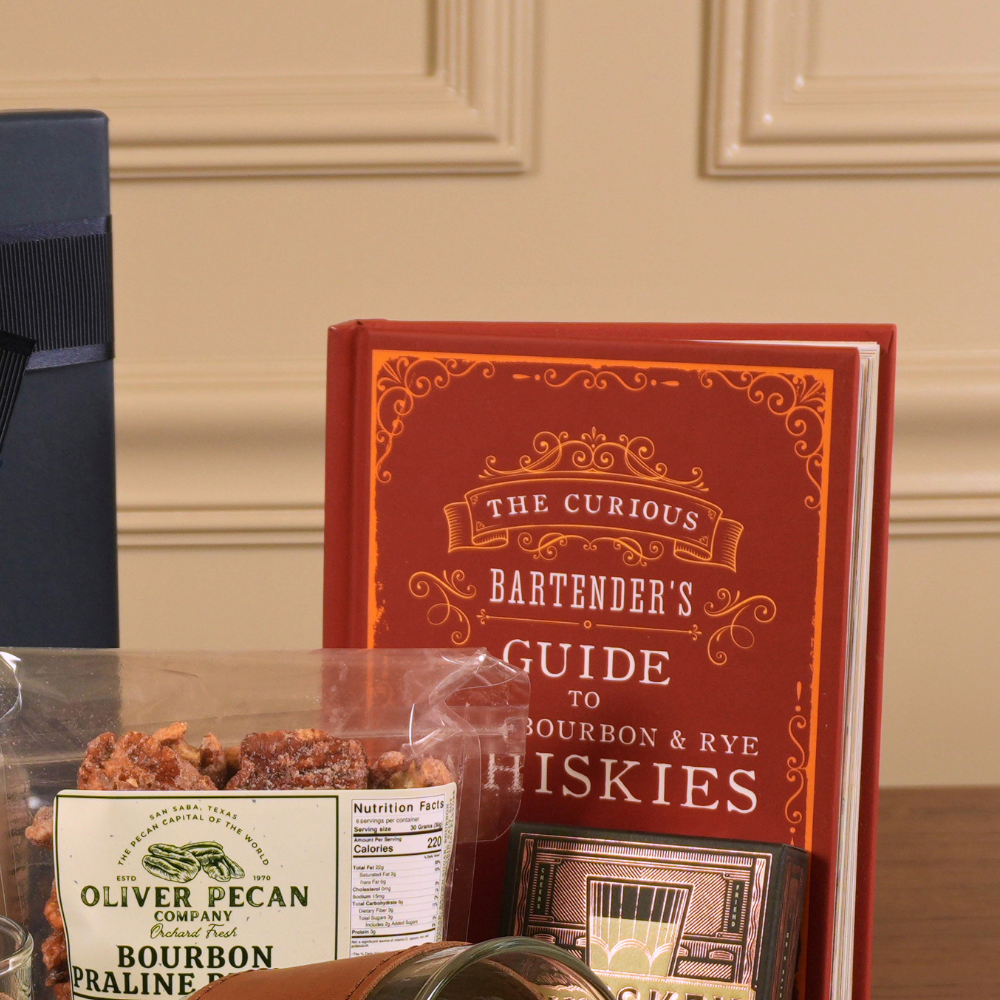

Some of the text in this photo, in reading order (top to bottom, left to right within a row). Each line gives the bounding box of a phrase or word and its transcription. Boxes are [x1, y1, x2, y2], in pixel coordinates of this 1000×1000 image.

[487, 493, 699, 531] THE CURIOUS
[490, 567, 693, 617] BARTENDER'S
[503, 638, 671, 686] GUIDE
[568, 689, 601, 709] TO
[670, 729, 687, 750] &
[700, 732, 760, 756] RYE
[483, 751, 758, 814] HISKIES
[149, 804, 238, 820] SAN SABA, TEXAS
[354, 800, 444, 814] Nutrition Facts
[354, 826, 378, 834] Serving
[360, 817, 384, 825] servings
[118, 814, 270, 867] THE PECAN CAPITAL OF THE WORLD
[353, 836, 441, 853] Calories 220
[80, 885, 309, 908] OLIVER PECAN
[154, 910, 233, 922] COMPANY
[150, 923, 238, 939] Orchard Fresh
[116, 945, 273, 969] BOURBON
[72, 965, 196, 996] PRALINE
